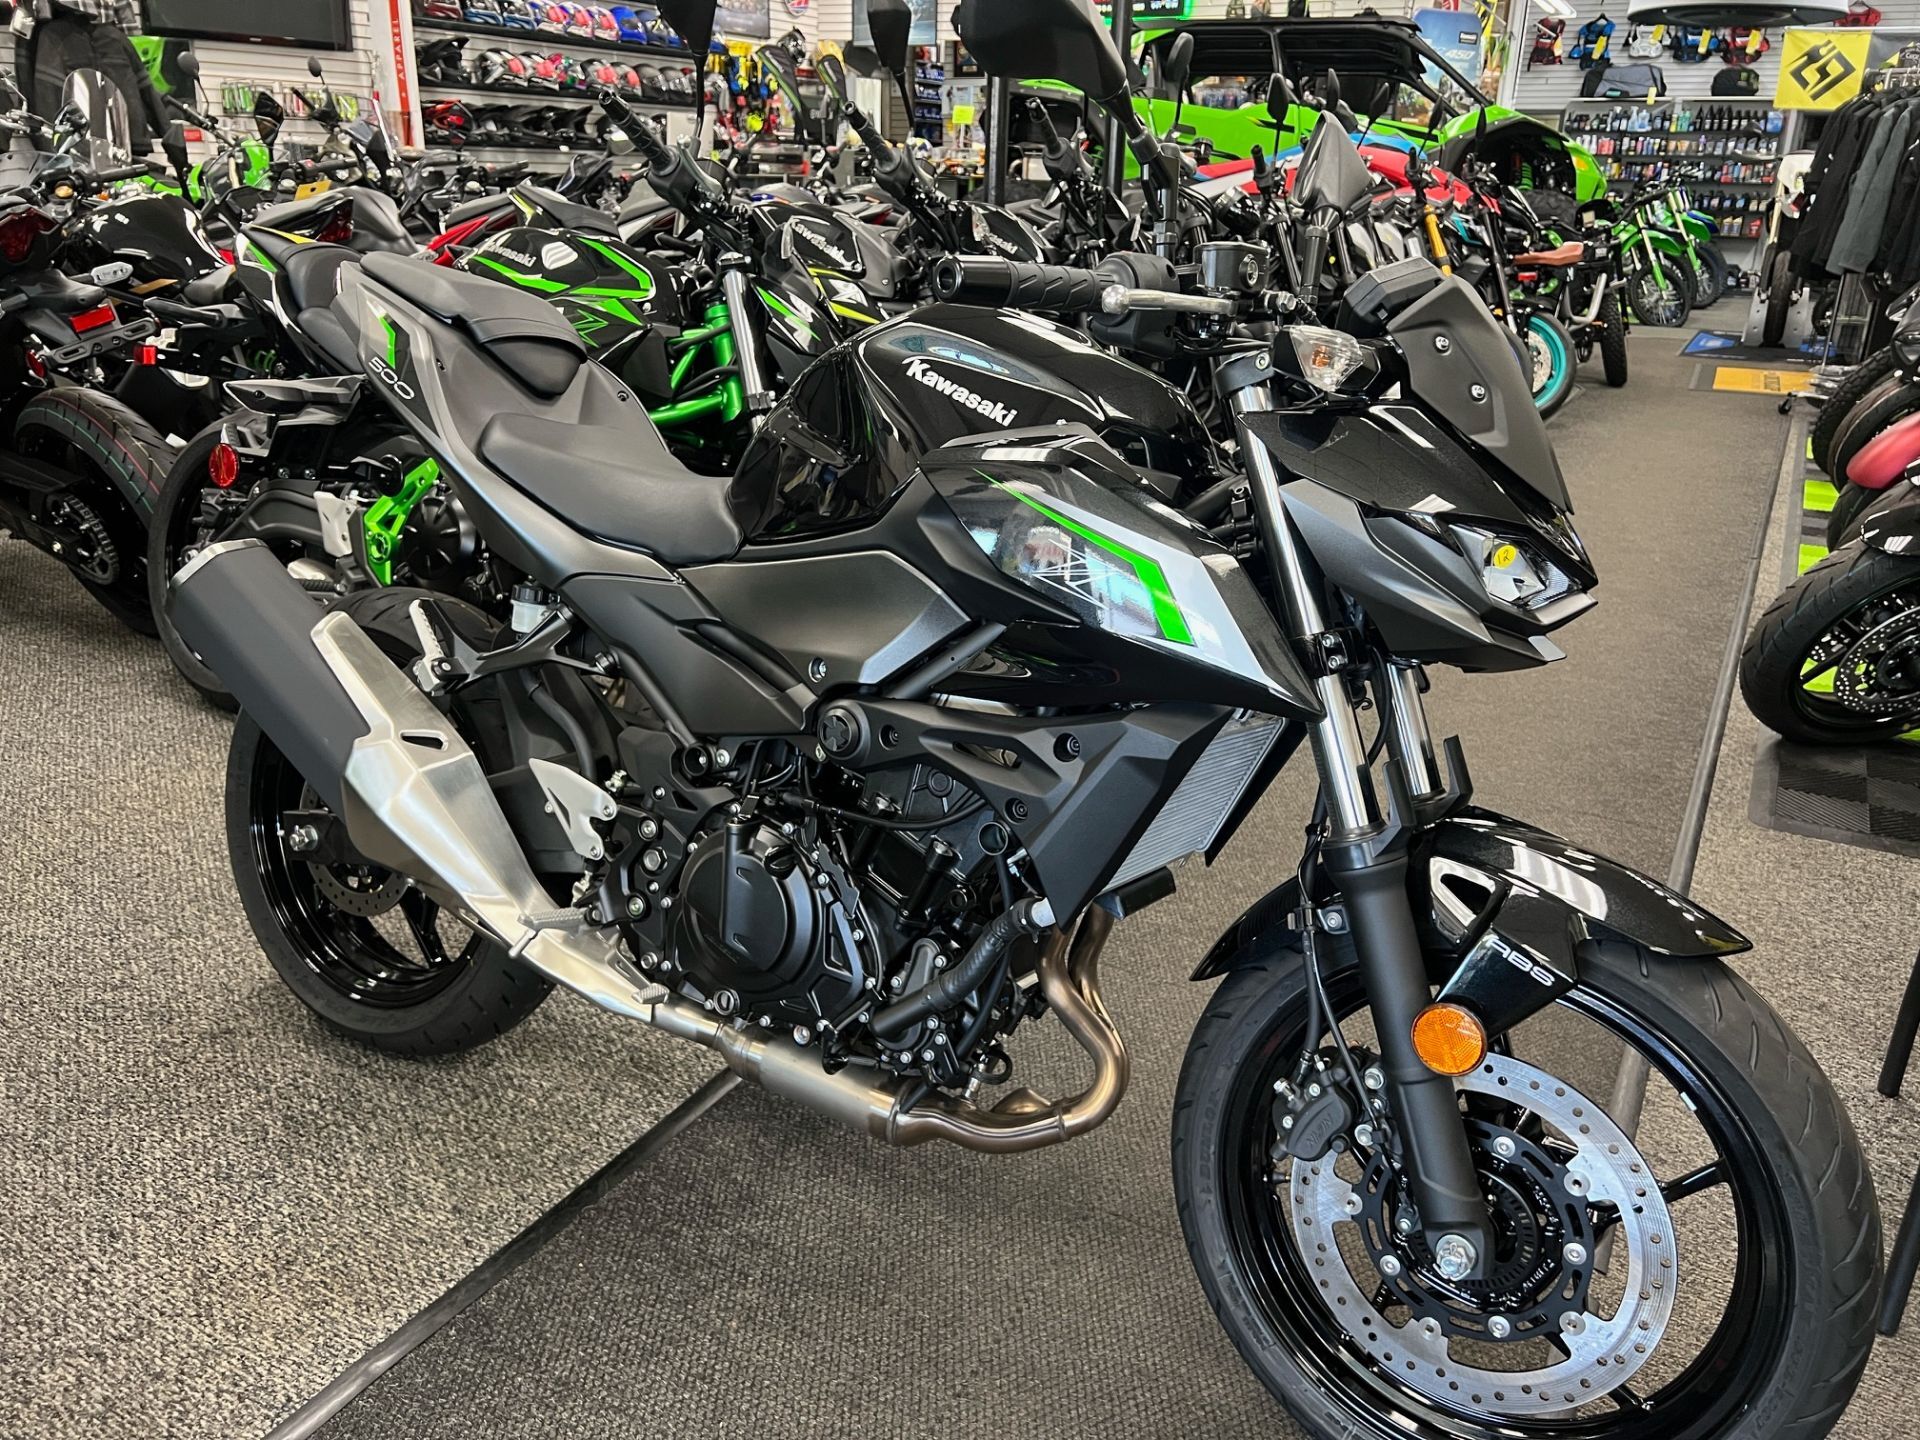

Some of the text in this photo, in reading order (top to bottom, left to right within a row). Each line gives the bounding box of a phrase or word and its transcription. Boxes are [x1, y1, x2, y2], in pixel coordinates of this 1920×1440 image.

[391, 17, 406, 80] APPAREL
[368, 356, 416, 400] 500
[905, 359, 1018, 427] Kawasaki
[1497, 549, 1511, 564] 12
[1485, 936, 1556, 987] ABS
